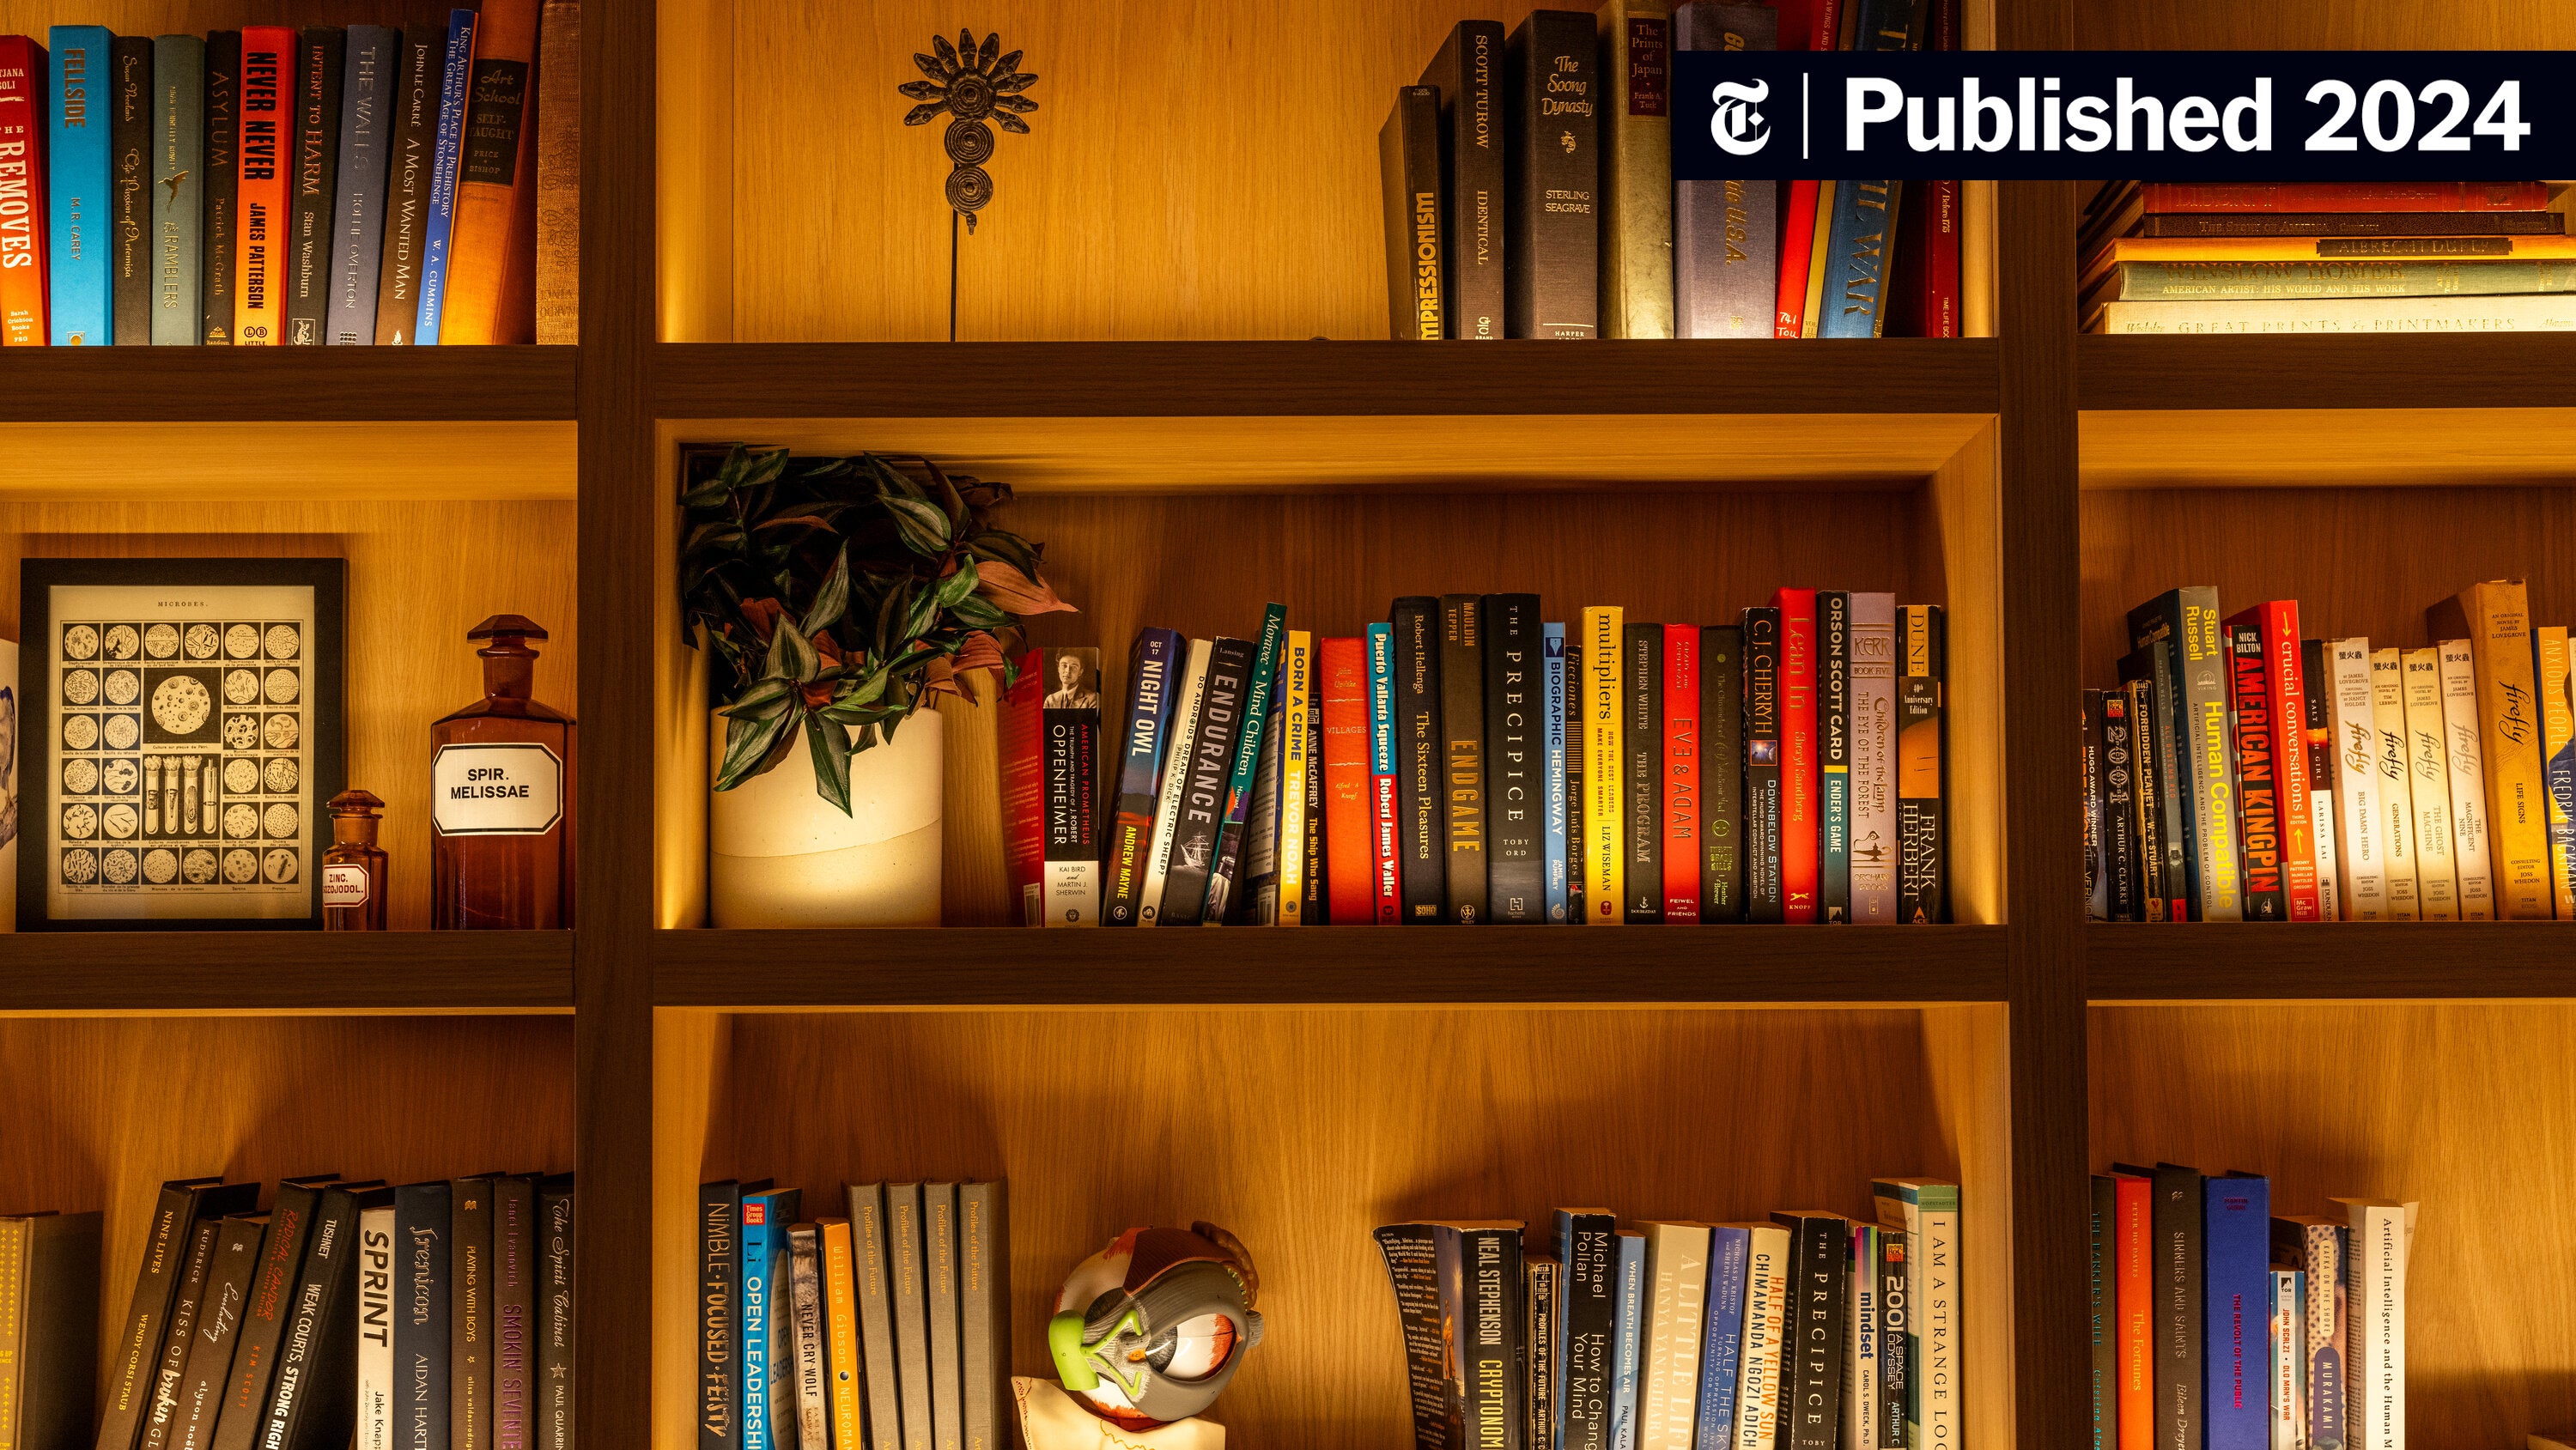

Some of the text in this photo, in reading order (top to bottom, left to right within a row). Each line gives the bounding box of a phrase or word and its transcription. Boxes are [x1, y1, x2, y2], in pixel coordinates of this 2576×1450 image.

[64, 48, 85, 129] FELLSIDE
[471, 86, 520, 106] School
[481, 69, 513, 86] Art
[1475, 34, 1489, 149] SCOTT TUROW
[1547, 73, 1587, 94] Soong
[1554, 55, 1579, 73] The
[212, 71, 228, 167] ASYLUM
[244, 52, 277, 180] NEVER NEVER
[304, 45, 325, 196] INTENT TO HARM
[1542, 98, 1593, 117] Dynasty
[1477, 190, 1489, 265] IDENTICAL
[1546, 190, 1589, 201] STERLING
[1546, 203, 1590, 213] SEAGRAVE
[247, 203, 266, 309] JAMES PATTERSON
[301, 212, 314, 298] Stan Washburn
[424, 240, 441, 327] W. A. CUMMINS
[2162, 284, 2406, 294] AMERICAN ARTIST: HIS WORLD AND HIS WORK
[1593, 613, 1616, 719] multipliers
[1911, 614, 1925, 673] DUNE
[2186, 605, 2203, 661] Russell
[2202, 610, 2218, 657] Stuart
[2237, 642, 2262, 653] BILTON
[2239, 632, 2257, 643] NICK
[1131, 659, 1163, 757] NIGHT OWL
[1831, 598, 1843, 761] ORSON SCOTT CARD
[2498, 681, 2531, 745] firefly
[1237, 681, 1267, 777] Mind Children
[1327, 725, 1367, 735] VILLAGES
[1506, 605, 1524, 822] THE PRECIPICE
[2281, 641, 2304, 812] crucial conversations
[467, 767, 509, 783] SPIR.
[1188, 673, 1237, 824] ENDURANCE
[1285, 646, 1307, 885] BORN A CRIME TREVOR NOAH
[1374, 634, 1394, 897] Puerto Vallarta Squeeze Robert James Waller
[1551, 661, 1564, 836] BIOGRAPHIC HEMINGWAY
[2236, 656, 2279, 893] AMERICAN KINGPIN
[2379, 729, 2404, 780] firefly
[450, 784, 530, 800] MELISSAE
[1053, 725, 1066, 845] OPPENHEIMER
[1415, 712, 1432, 859] The Sixteen Pleasures
[1451, 740, 1480, 852] ENDGAME
[1831, 780, 1842, 853] ENDER'S GAME
[2203, 701, 2233, 909] Human Compatible
[1767, 780, 1777, 903] DOWNBELOW STATION
[1903, 804, 1919, 901] HERBERT
[1920, 814, 1936, 889] FRANK
[2359, 810, 2368, 834] DAMN
[2361, 837, 2370, 861] HERO
[2391, 803, 2403, 857] GENERATIONS
[329, 874, 348, 883] ZINC.
[1117, 825, 1137, 900] ANDREW MAYNE
[1601, 826, 1611, 891] LIZ WISEMAN
[151, 1210, 173, 1274] NINE LIVES
[1577, 1231, 1590, 1282] Pollan
[1592, 1231, 1609, 1299] Michael
[2383, 1218, 2392, 1272] Artificial
[363, 1229, 389, 1348] SPRINT
[747, 1277, 762, 1332] OPEN
[833, 1245, 848, 1365] William Gibson
[1478, 1237, 1502, 1345] NEAL STEPHENSON
[1886, 1277, 1904, 1331] 2001
[2324, 1274, 2329, 1284] ON
[2383, 1277, 2393, 1344] Intelligence
[275, 1283, 323, 1417] WEAK COURTS, STRONG
[802, 1304, 817, 1398] NEVER CRY WOLF
[1807, 1232, 1829, 1426] THE PRECIPICE
[1860, 1292, 1876, 1359] mindset
[1896, 1334, 1904, 1344] A
[2384, 1348, 2392, 1368] and
[414, 1353, 428, 1401] AIDAN
[1571, 1332, 1589, 1420] Your Mind
[1887, 1333, 1896, 1389] ODYSSEY
[2323, 1362, 2332, 1429] MURAKAMI
[2385, 1396, 2393, 1438] Human
